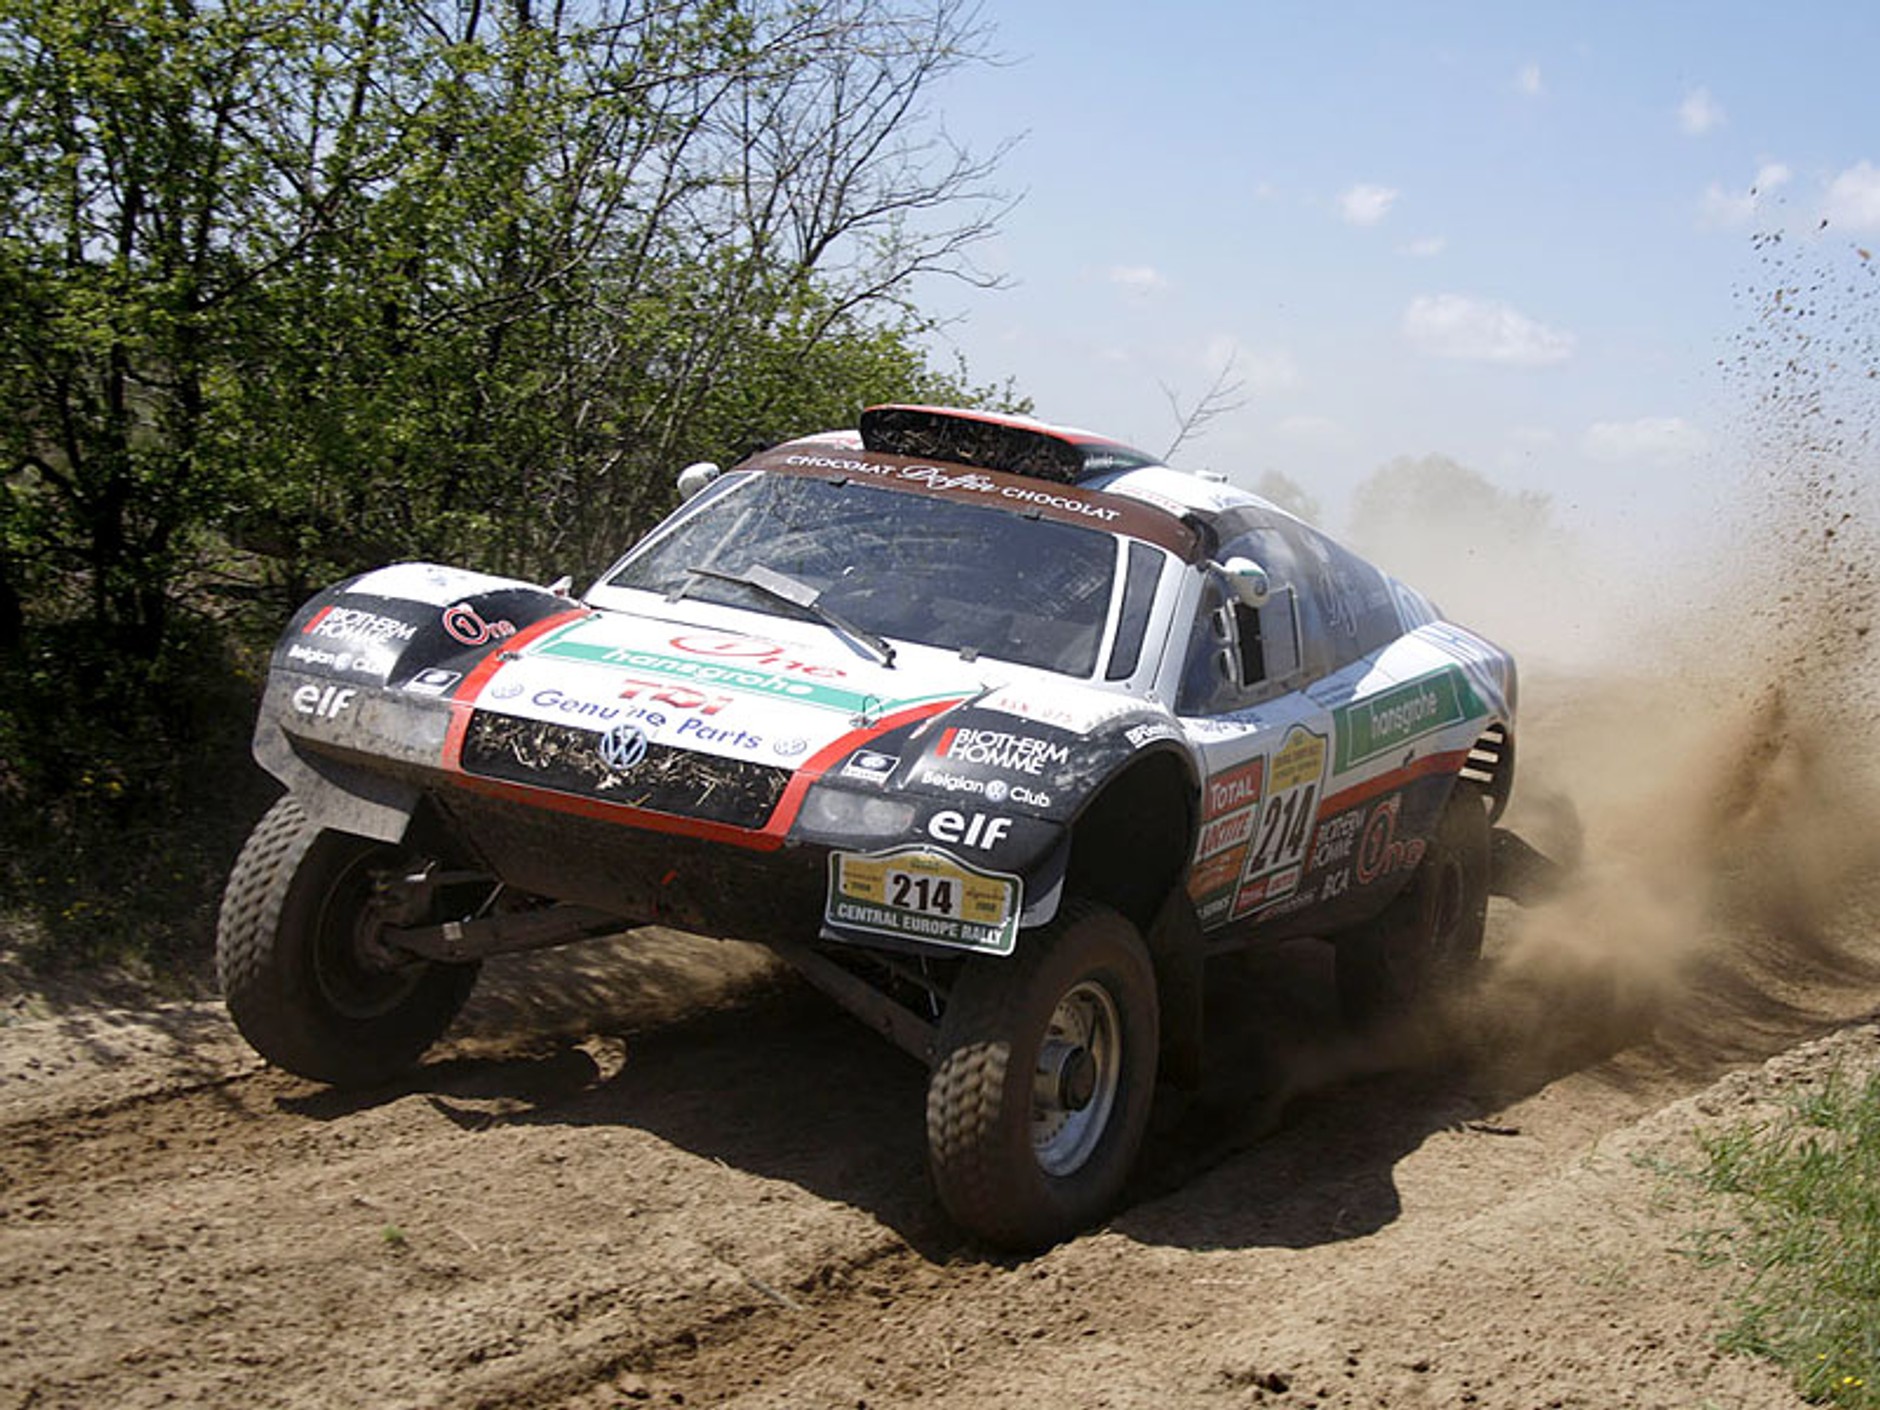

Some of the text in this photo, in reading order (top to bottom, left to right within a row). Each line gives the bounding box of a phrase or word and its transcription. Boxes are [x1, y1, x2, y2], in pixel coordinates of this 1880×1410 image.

[786, 455, 896, 475] CHOCOLAT
[1001, 486, 1121, 521] CHOCOLAT
[600, 648, 815, 696] hansgrohe
[292, 684, 358, 719] elf
[1371, 691, 1438, 739] hansgrohe
[676, 717, 763, 750] Parts
[954, 728, 1069, 764] BIOTHERM
[946, 744, 1046, 775] HOMME
[921, 769, 1051, 807] Belgian Club
[927, 809, 1013, 851] elf
[1249, 785, 1316, 874] 214
[892, 874, 953, 915] 214
[837, 902, 1004, 945] CENTRAL EUROPE RALLY
